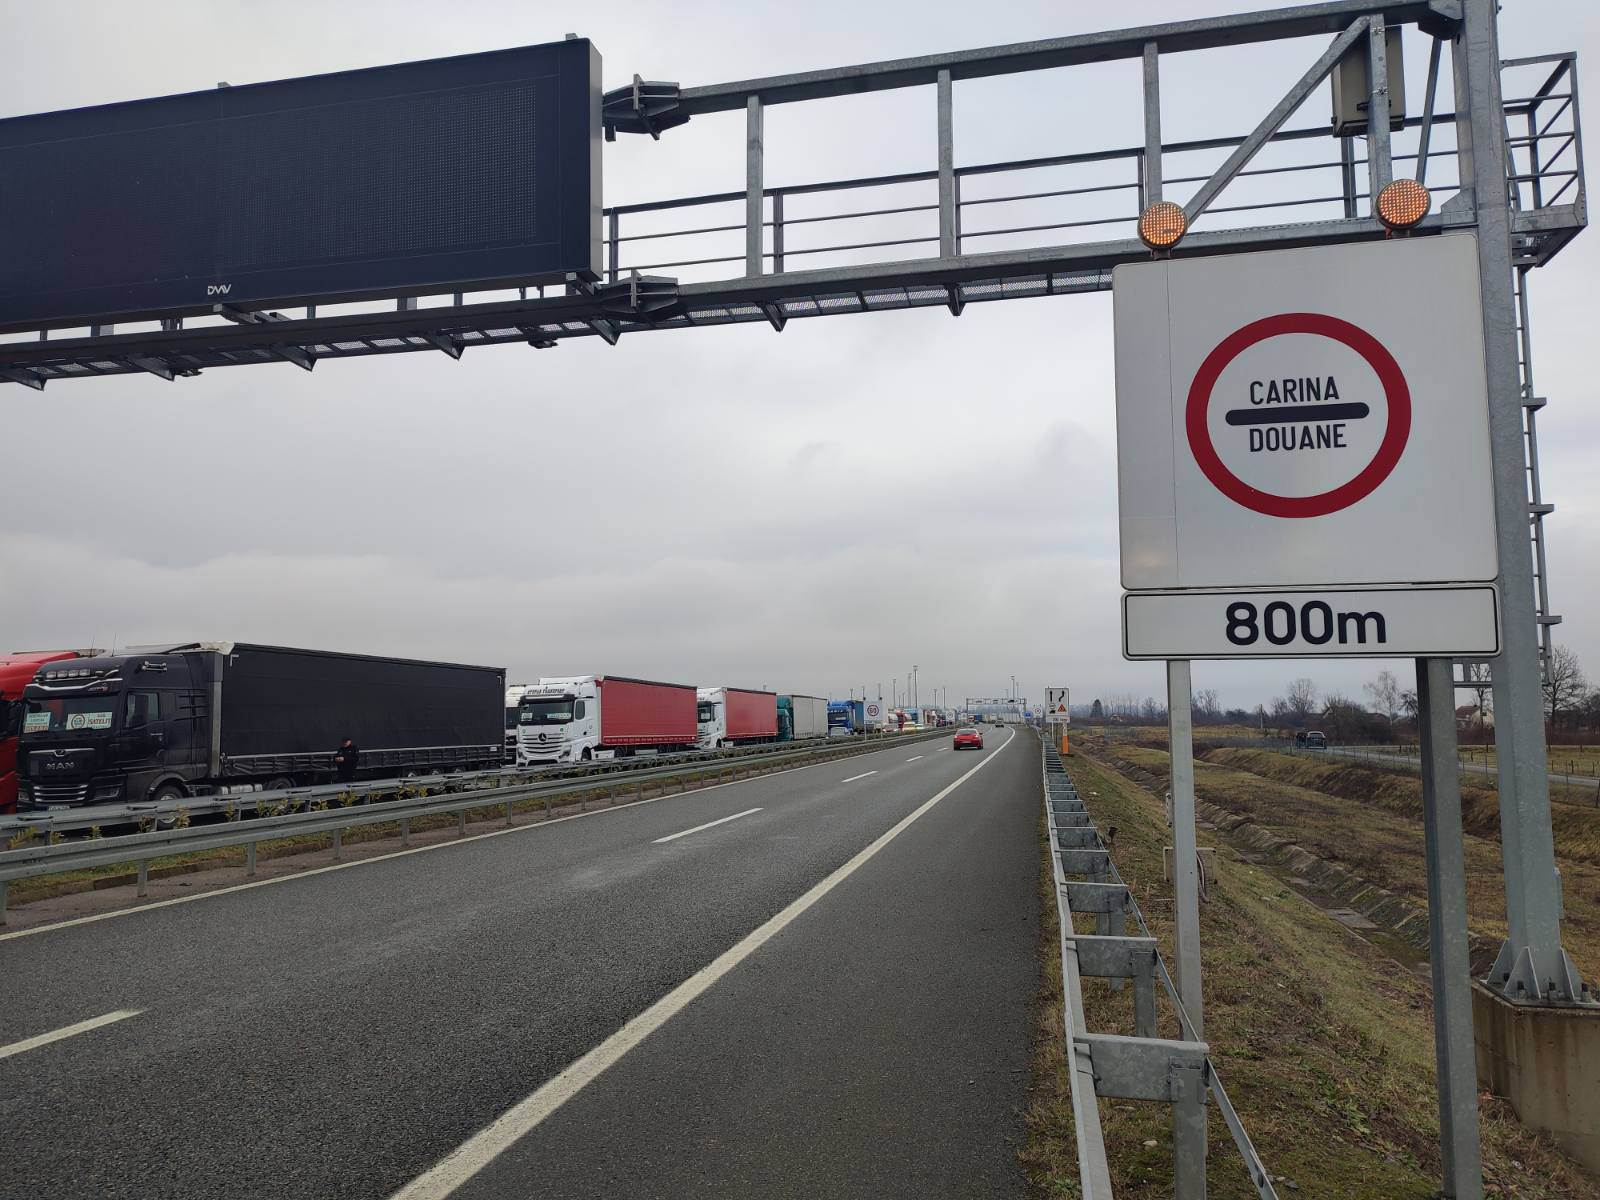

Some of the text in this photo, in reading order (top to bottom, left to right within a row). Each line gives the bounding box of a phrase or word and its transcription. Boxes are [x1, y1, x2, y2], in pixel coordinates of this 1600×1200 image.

[1249, 376, 1340, 405] CARINA
[1249, 423, 1347, 452] DOUANE
[1225, 599, 1387, 646] 800m
[46, 762, 74, 770] MAN
